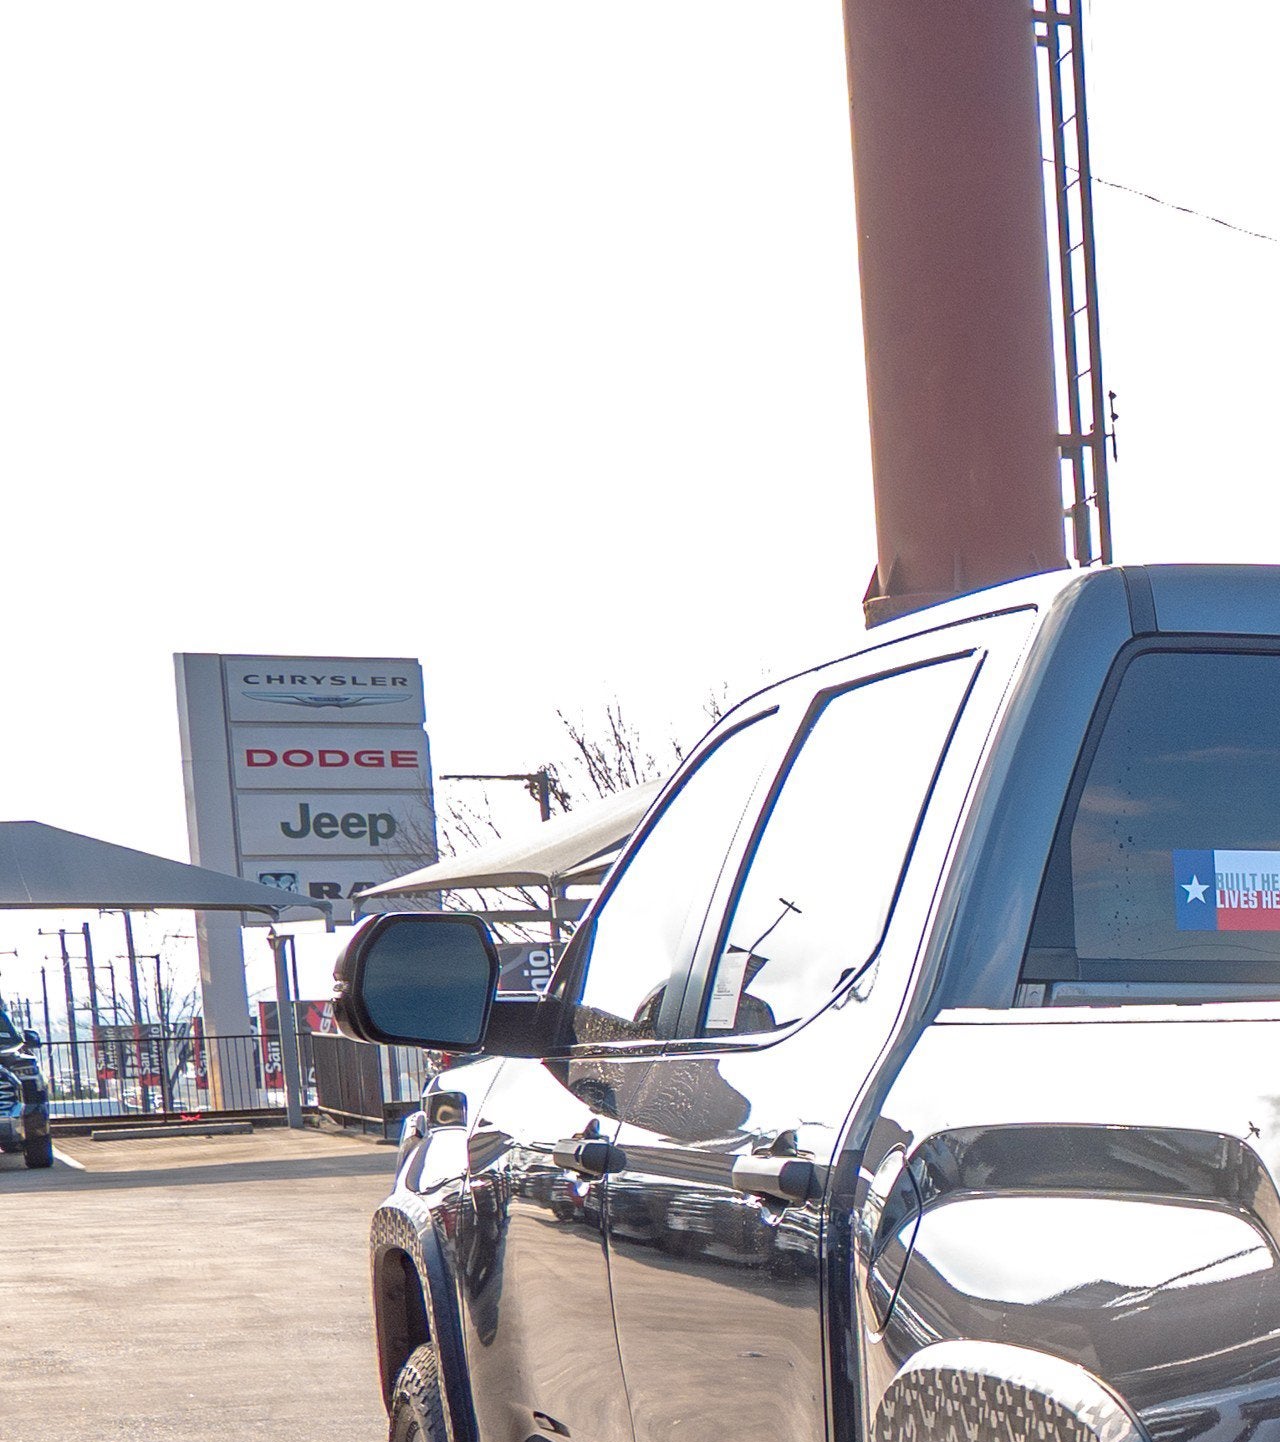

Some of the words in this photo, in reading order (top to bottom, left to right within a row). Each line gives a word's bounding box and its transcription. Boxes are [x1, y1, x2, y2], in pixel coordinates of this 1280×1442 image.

[242, 674, 408, 687] CHRYSLER
[245, 749, 419, 768] DODGE
[280, 803, 397, 847] Jeep
[1215, 872, 1258, 891] BUILT
[1216, 890, 1259, 909] LIVES
[141, 1052, 151, 1075] San
[265, 1041, 282, 1074] San
